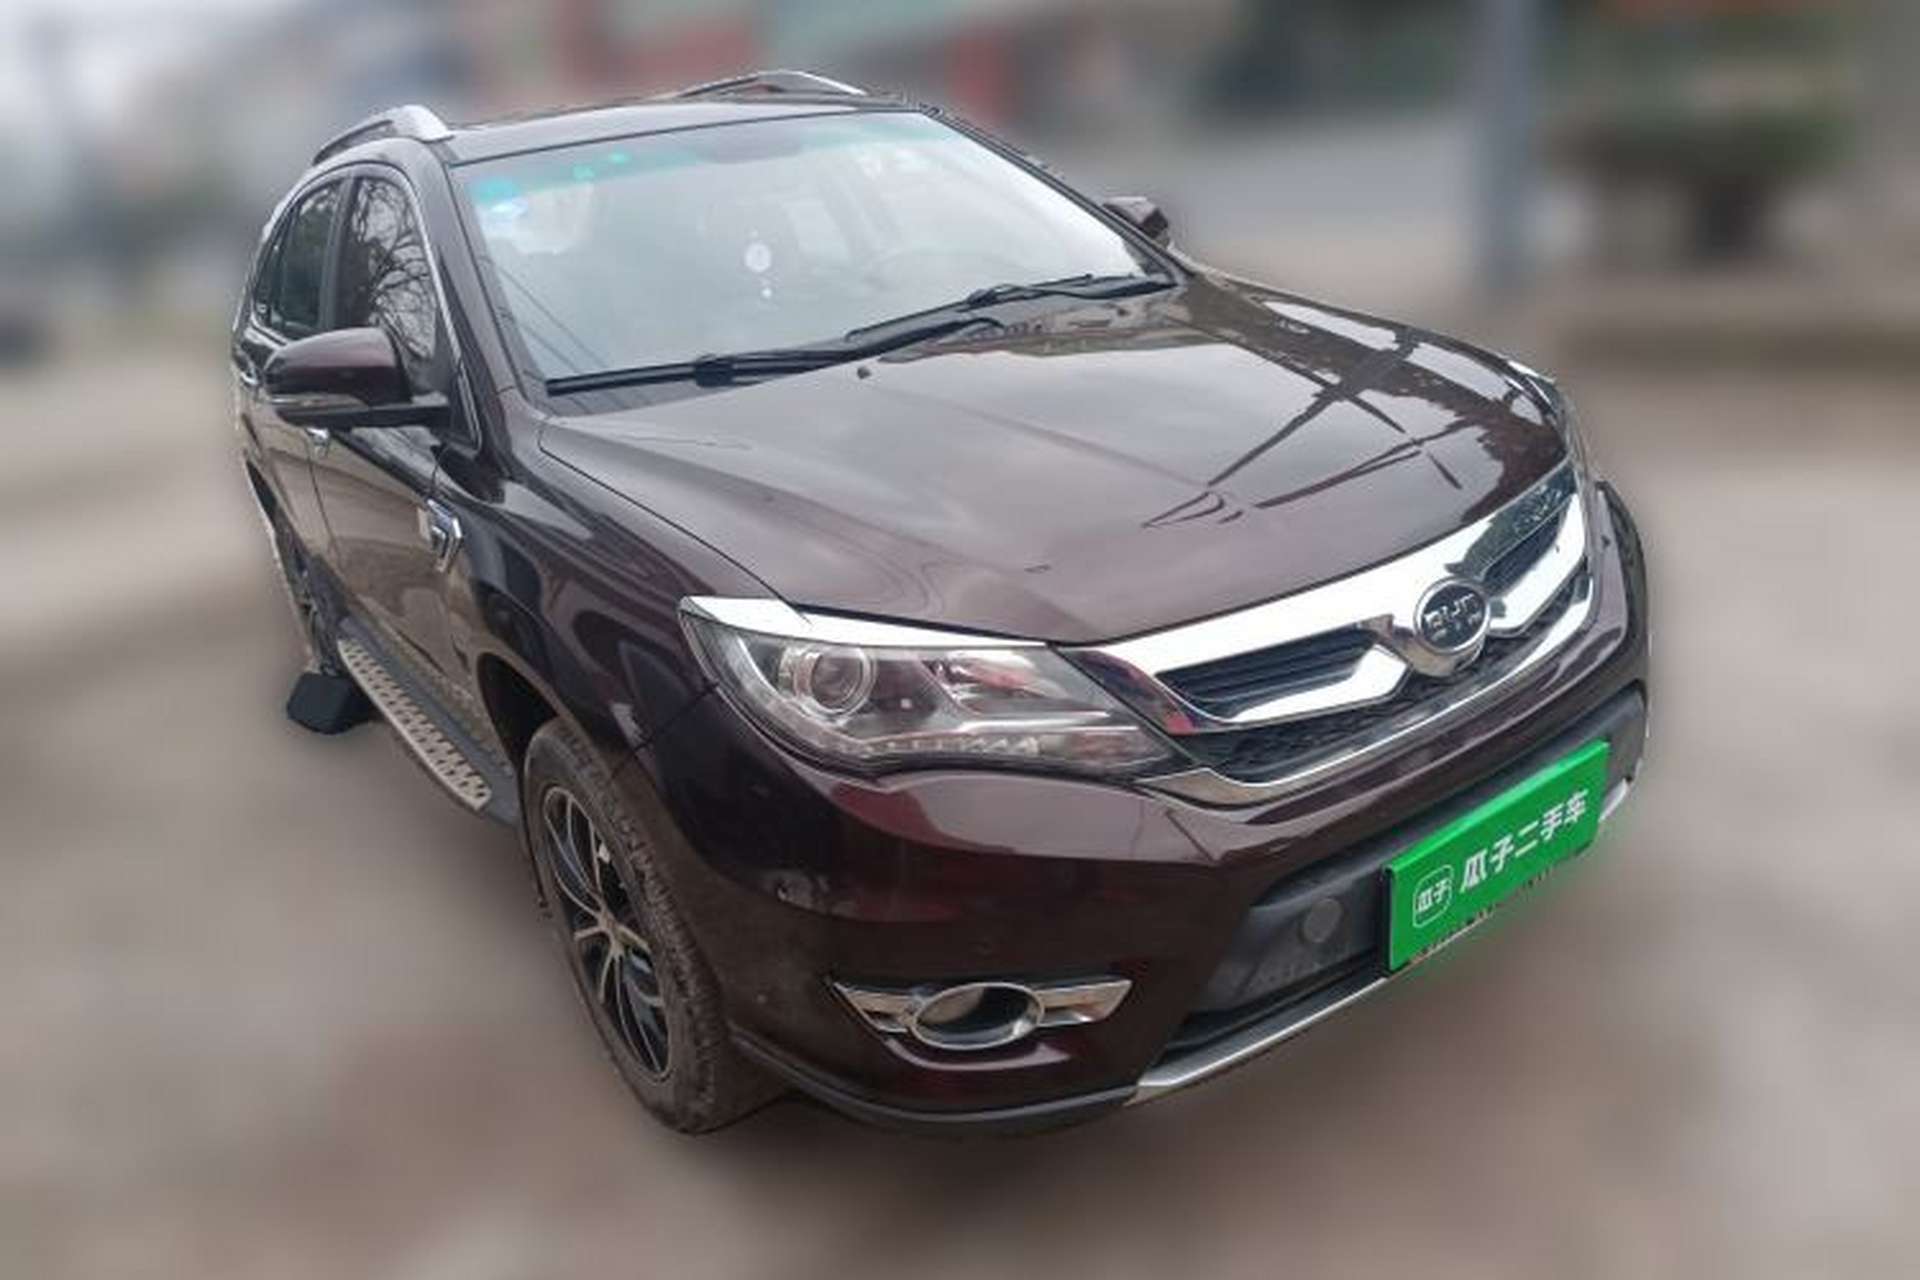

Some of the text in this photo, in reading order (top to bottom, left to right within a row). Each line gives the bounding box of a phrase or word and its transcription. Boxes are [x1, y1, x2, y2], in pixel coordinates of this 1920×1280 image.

[1460, 789, 1589, 892] 瓜子二手车
[1416, 878, 1450, 913] 瓜子
